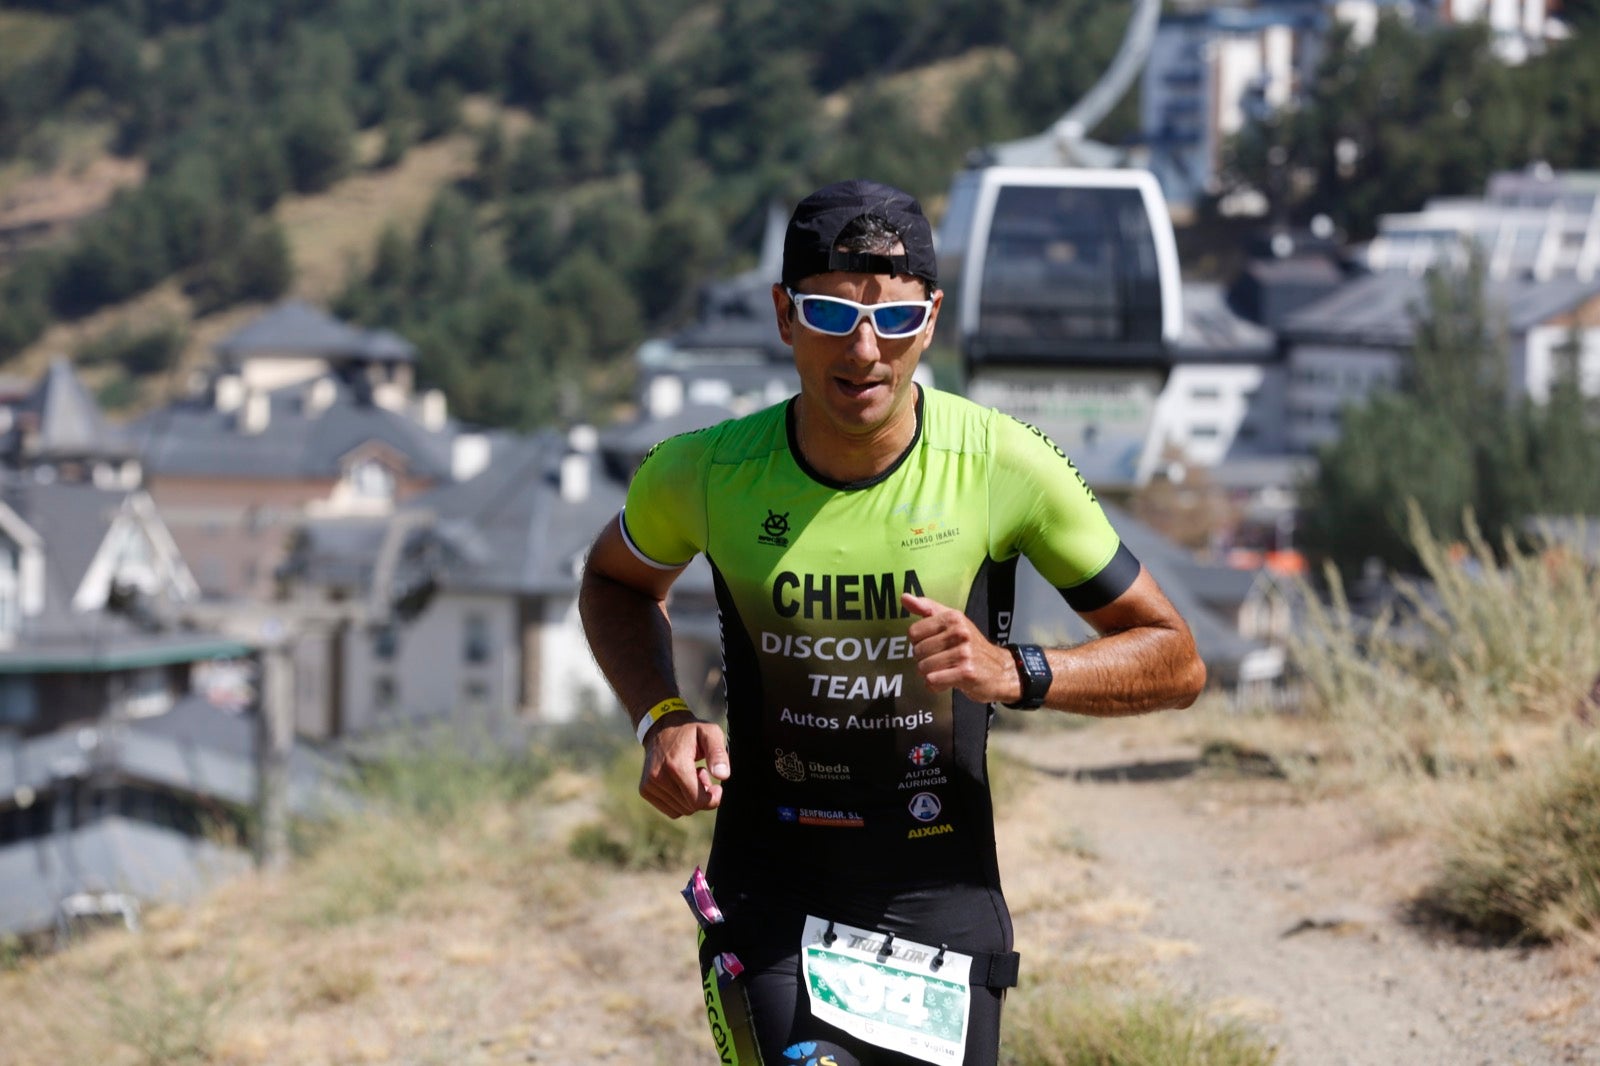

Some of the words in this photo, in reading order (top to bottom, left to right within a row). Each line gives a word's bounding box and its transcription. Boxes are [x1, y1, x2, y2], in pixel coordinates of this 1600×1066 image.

[901, 535, 934, 548] ALFONSO
[773, 569, 926, 621] CHEMA
[761, 631, 914, 662] DISCOVE
[808, 674, 903, 701] TEAM
[780, 708, 840, 730] Autos
[845, 709, 934, 730] Auringis
[810, 772, 851, 781] mariscos
[897, 775, 948, 790] AURINGIS
[905, 767, 941, 780] AUTOS
[908, 823, 954, 839] AIXAM
[847, 963, 929, 1027] 94
